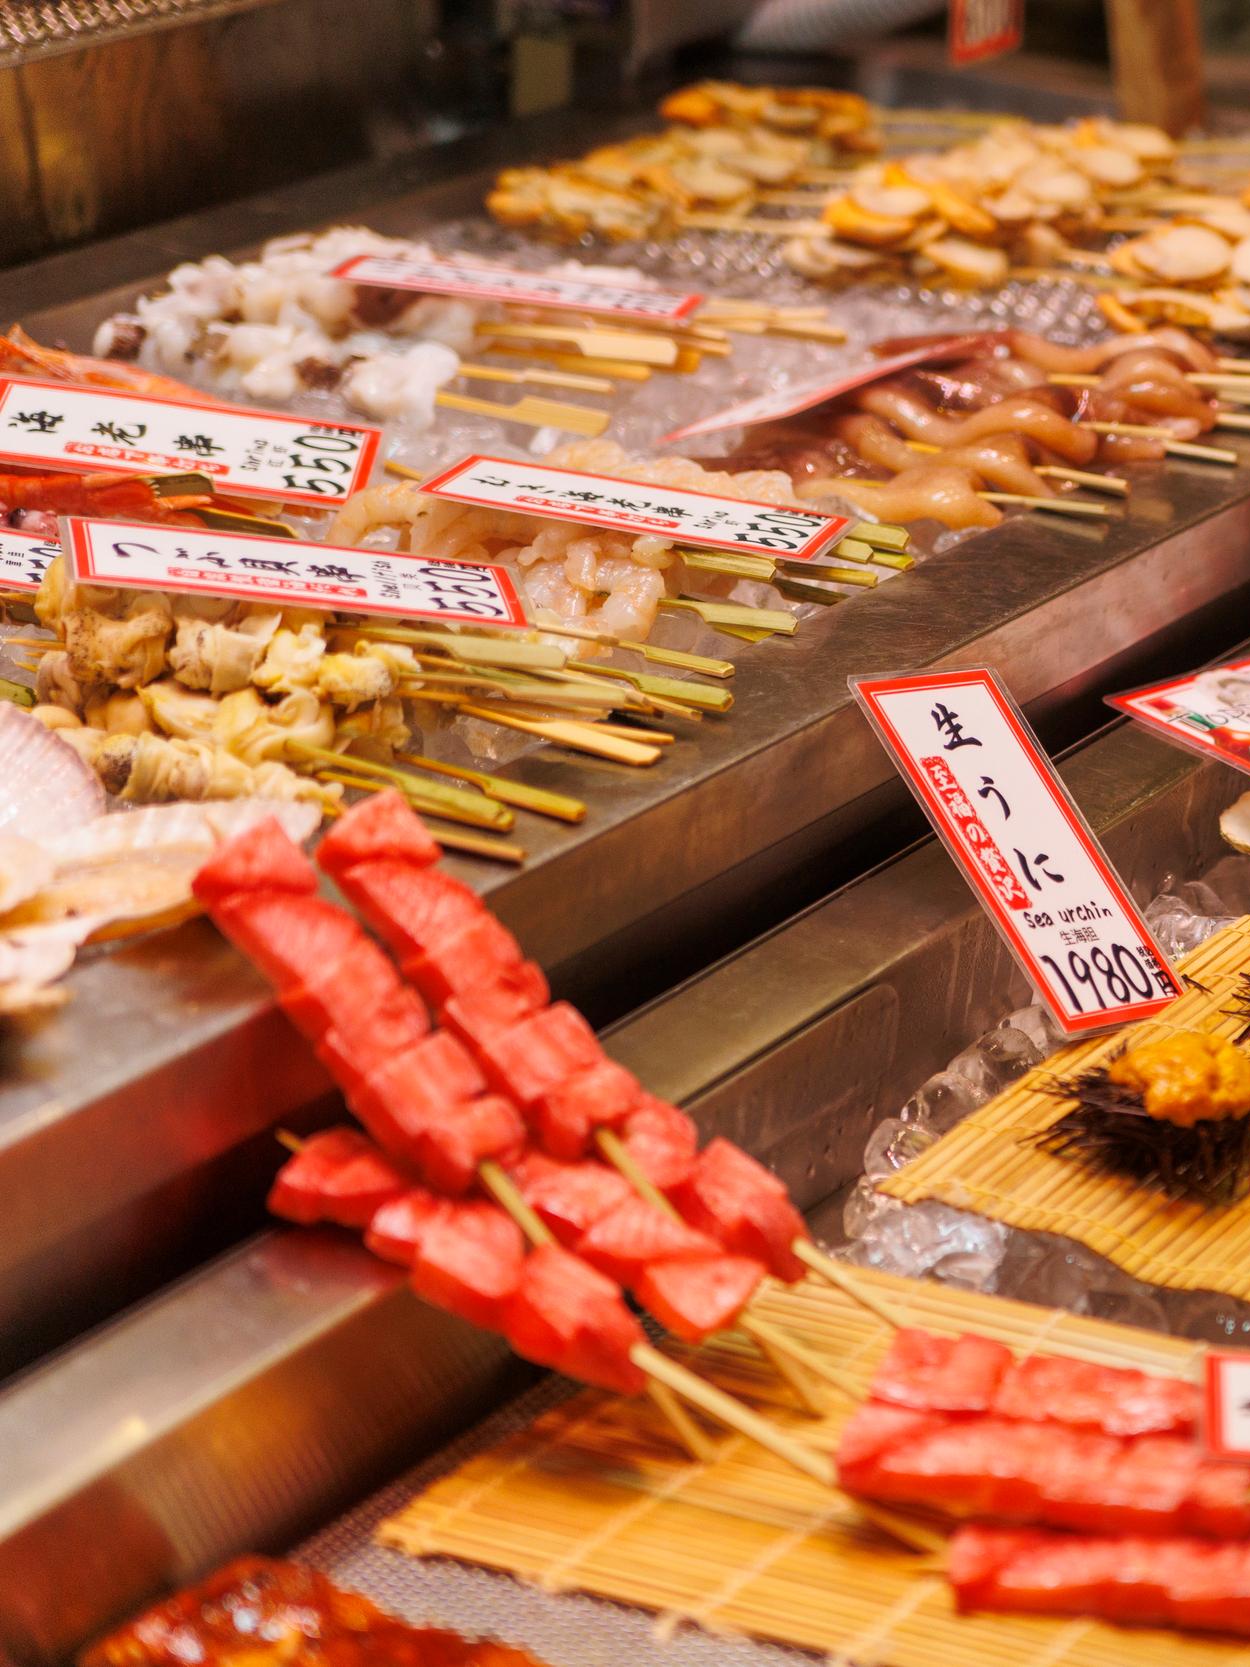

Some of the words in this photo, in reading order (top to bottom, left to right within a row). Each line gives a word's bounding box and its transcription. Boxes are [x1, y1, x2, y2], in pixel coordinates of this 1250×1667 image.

[8, 409, 227, 458] 海老串
[282, 434, 359, 496] 550
[733, 512, 823, 551] 550
[112, 541, 365, 583] つぶ貝串
[370, 559, 402, 600] Shellfish
[418, 566, 505, 617] 550
[930, 702, 1065, 891] 生うに
[1060, 901, 1112, 924] urchin
[1059, 926, 1101, 947] 生海胆
[1038, 943, 1154, 1013] 1980
